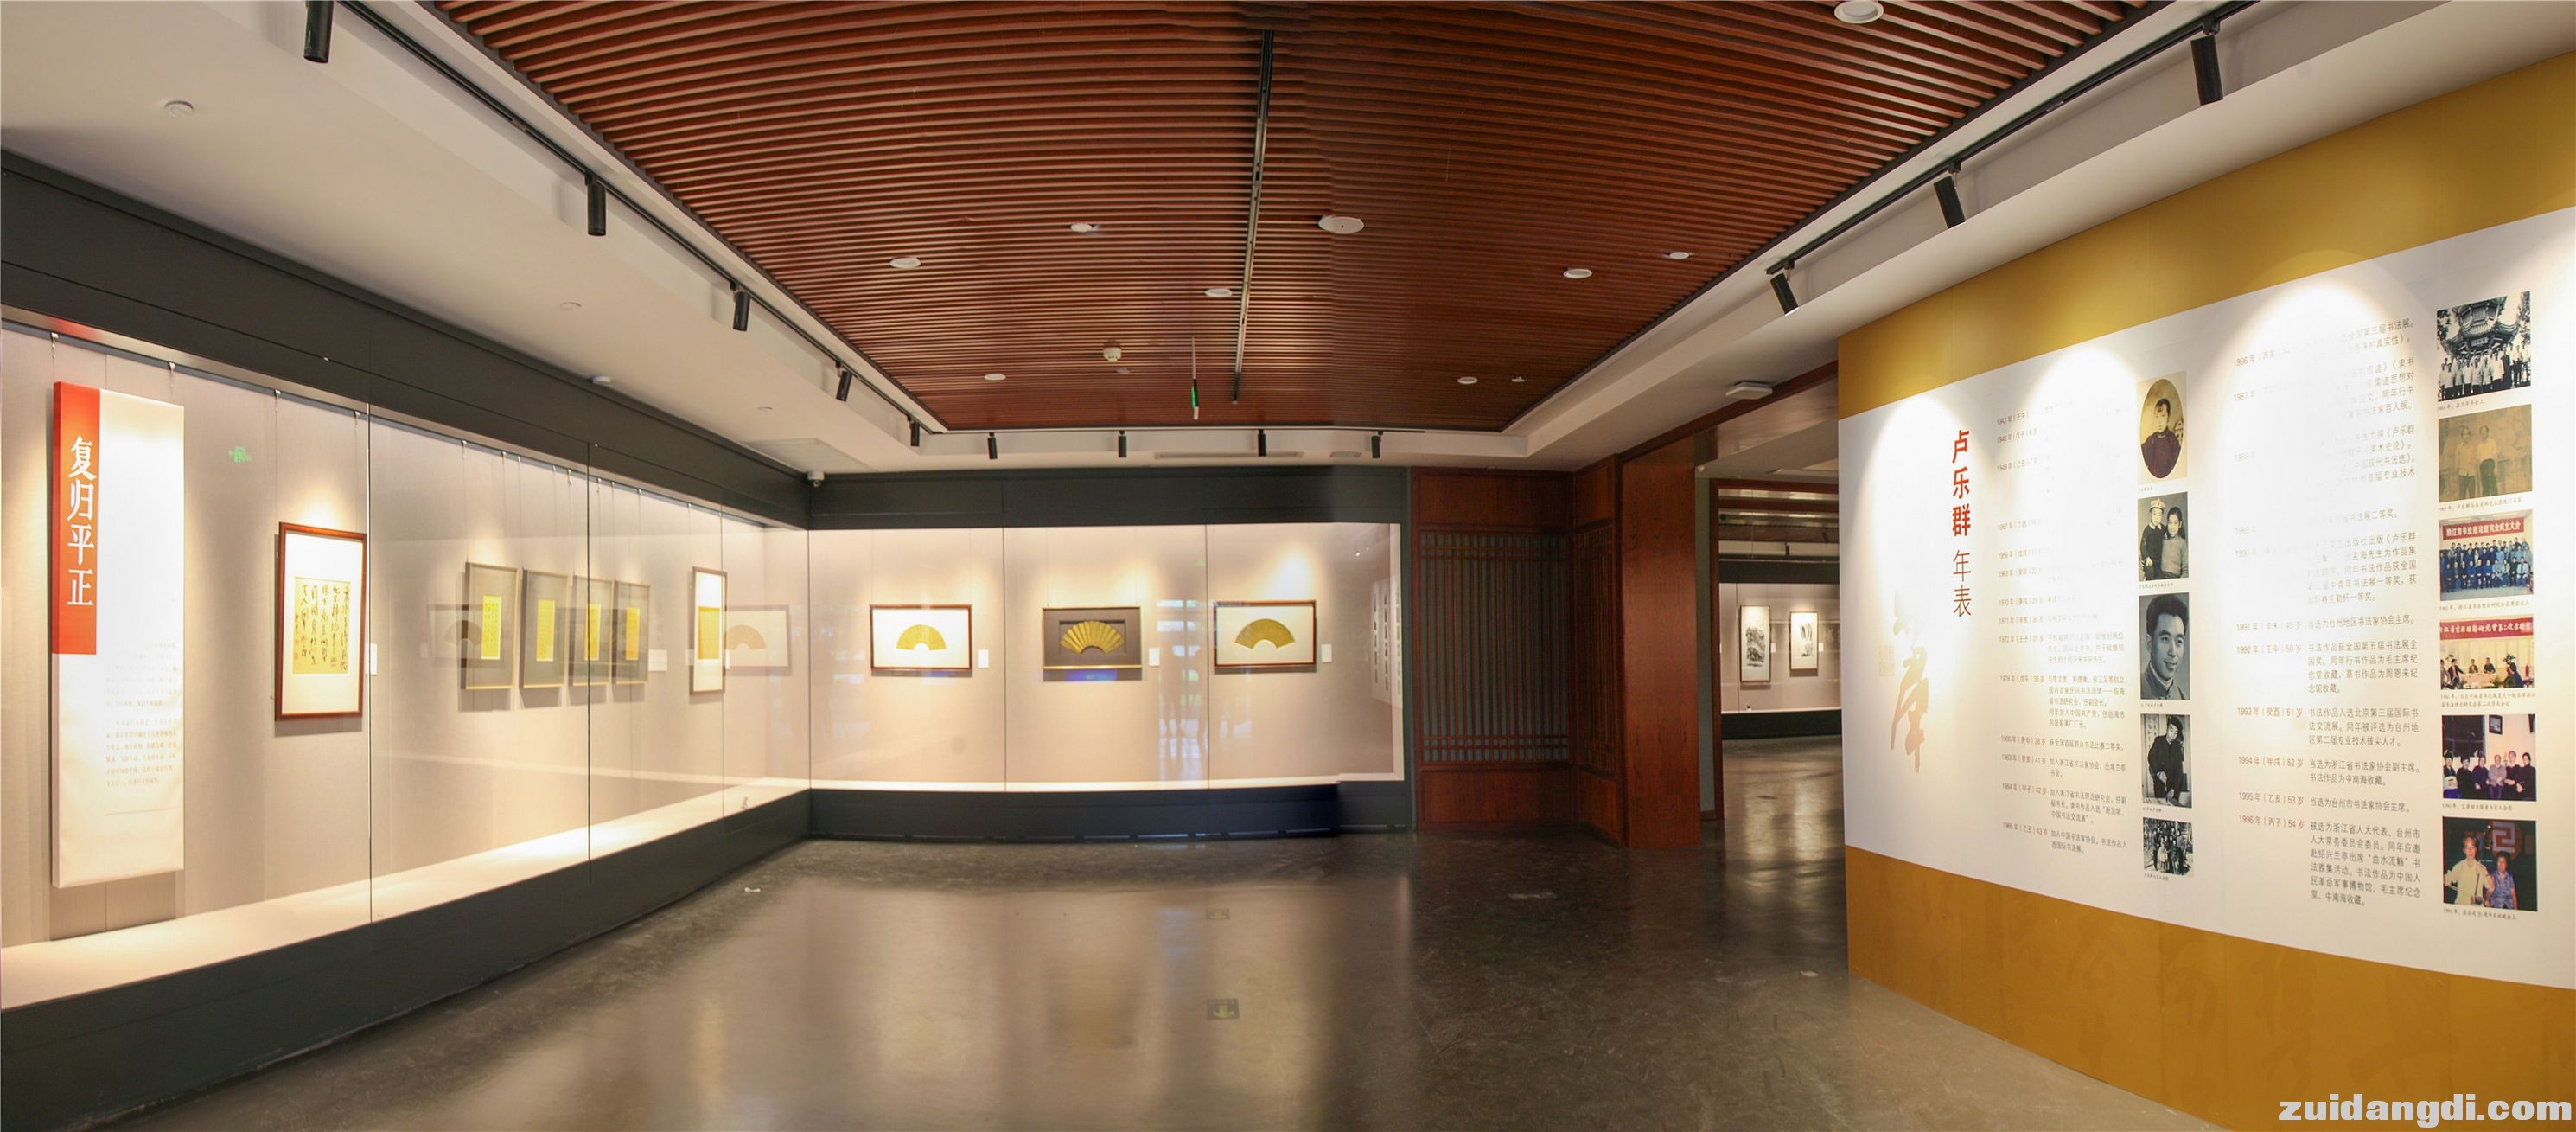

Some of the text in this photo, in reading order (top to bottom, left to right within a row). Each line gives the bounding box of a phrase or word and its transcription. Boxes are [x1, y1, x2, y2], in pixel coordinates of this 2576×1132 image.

[67, 435, 96, 606] 复归平正
[1952, 429, 1972, 617] 卢乐群 年表
[2309, 707, 2420, 719] 书法作品入选北京第三届国际书
[2309, 721, 2420, 732] 法交流展。同年被评选为台州地
[2309, 735, 2401, 747] 区第二届专业技术拔尖人才。
[2309, 759, 2420, 774] 当选为浙江省书法家协会副主席。
[2310, 773, 2387, 787] 书法作品为中南海收藏。
[2310, 796, 2410, 813] 当选为台州市书法家协会主席。
[2310, 821, 2420, 839] 被选为浙江省人大代表、台州市
